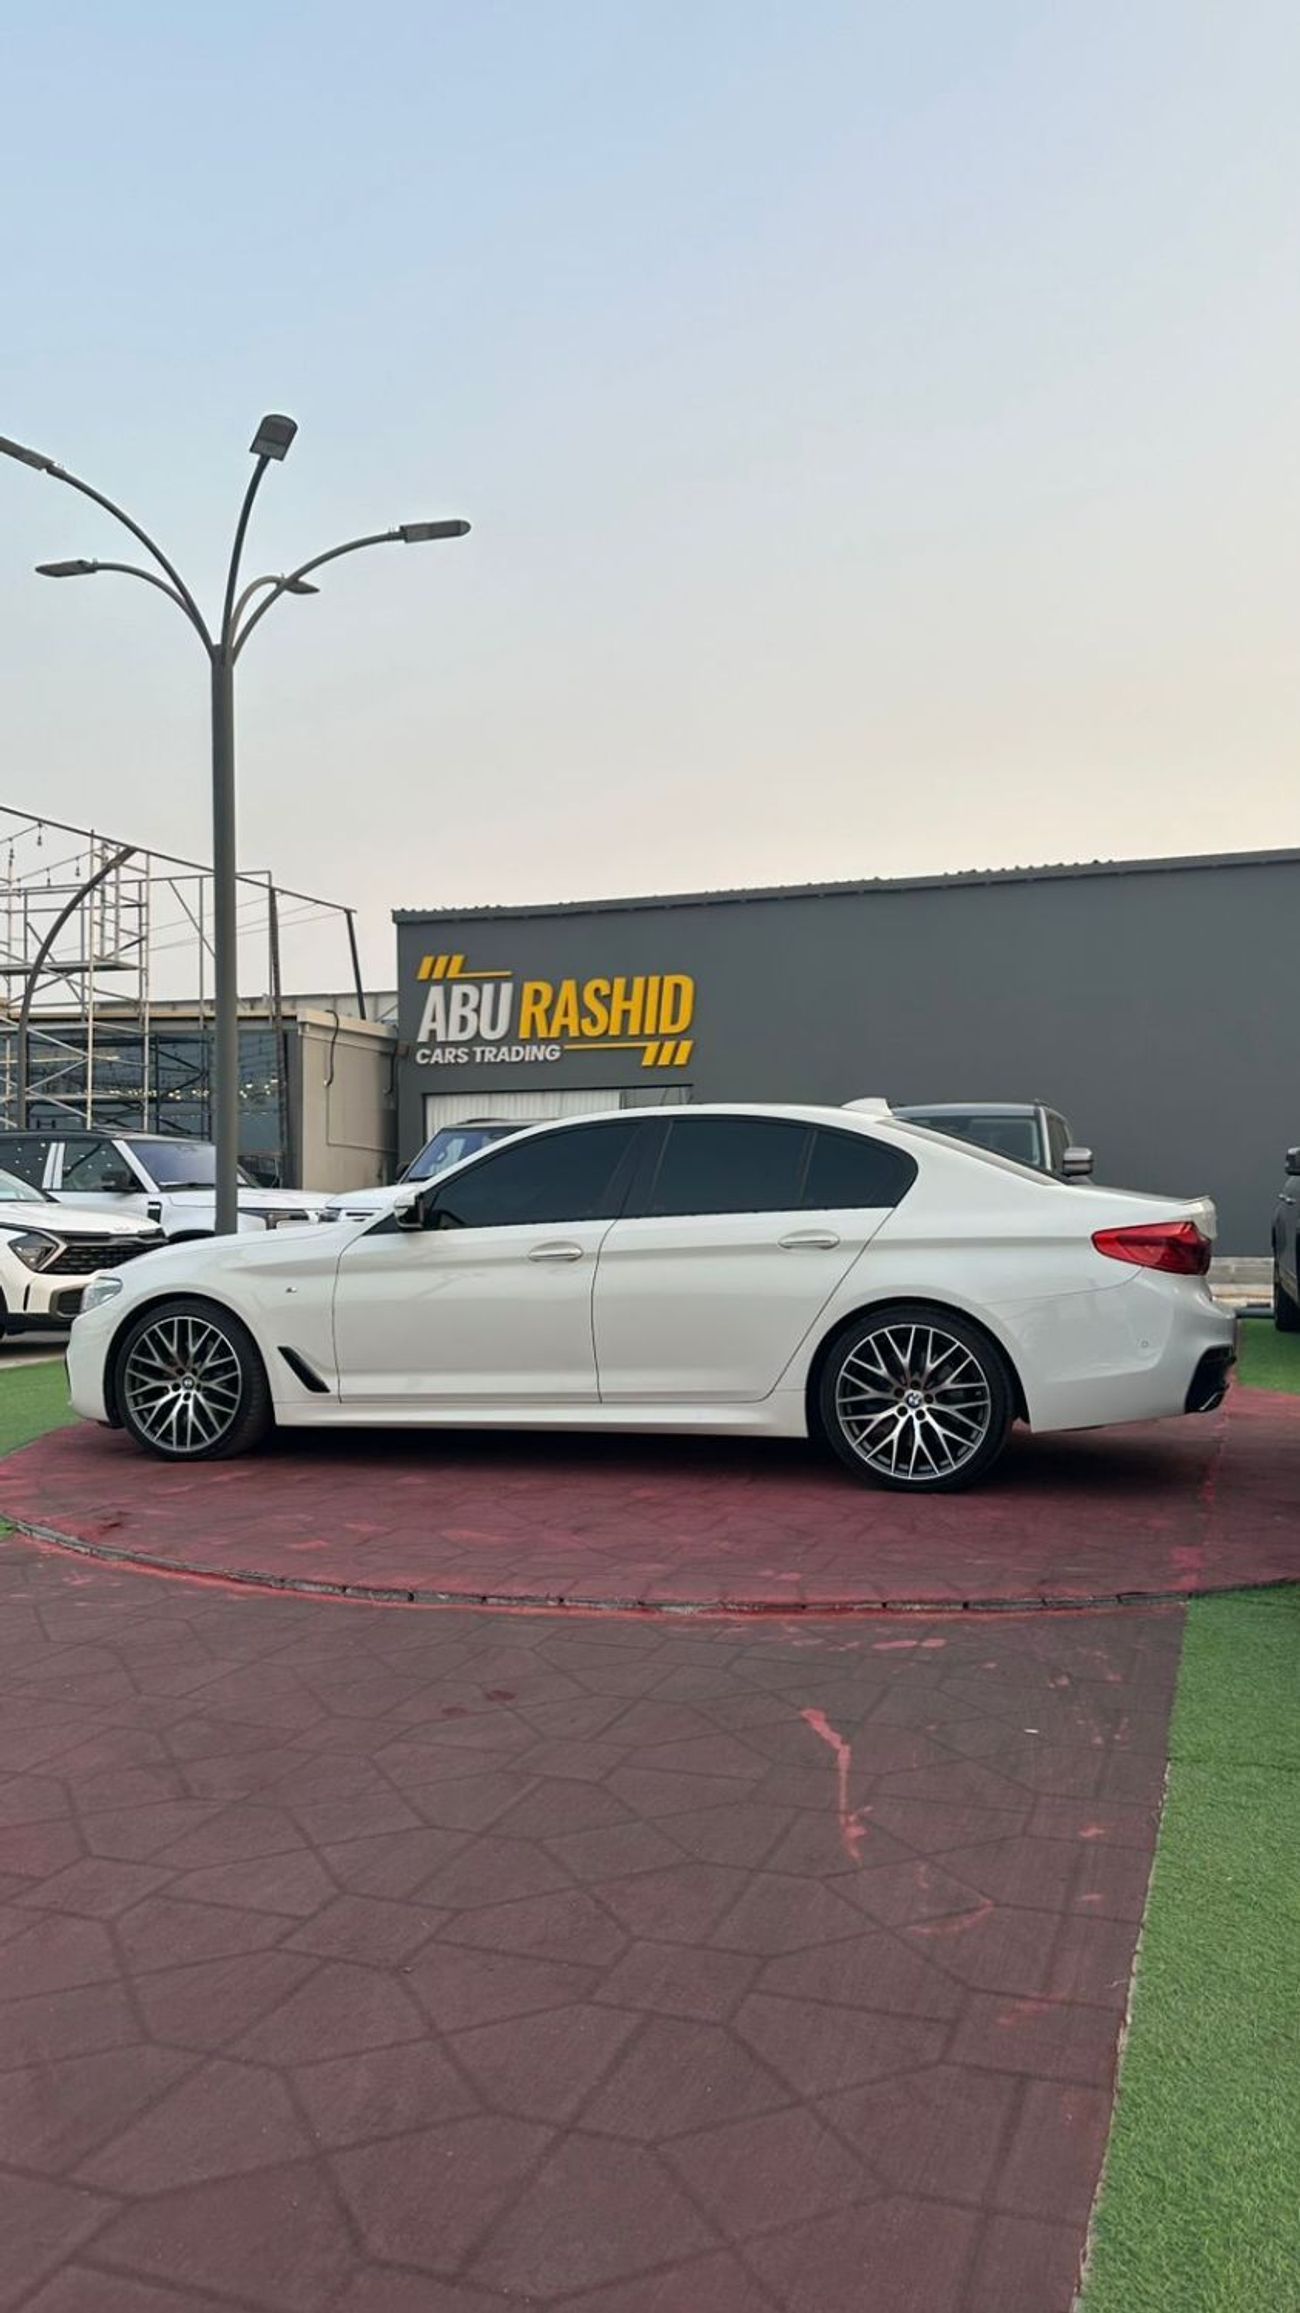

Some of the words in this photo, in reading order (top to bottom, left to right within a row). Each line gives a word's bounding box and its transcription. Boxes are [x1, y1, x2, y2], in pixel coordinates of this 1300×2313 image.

[416, 982, 513, 1042] ABU
[519, 975, 695, 1040] RASHID
[416, 1047, 469, 1064] CARS
[473, 1045, 561, 1063] TRADING
